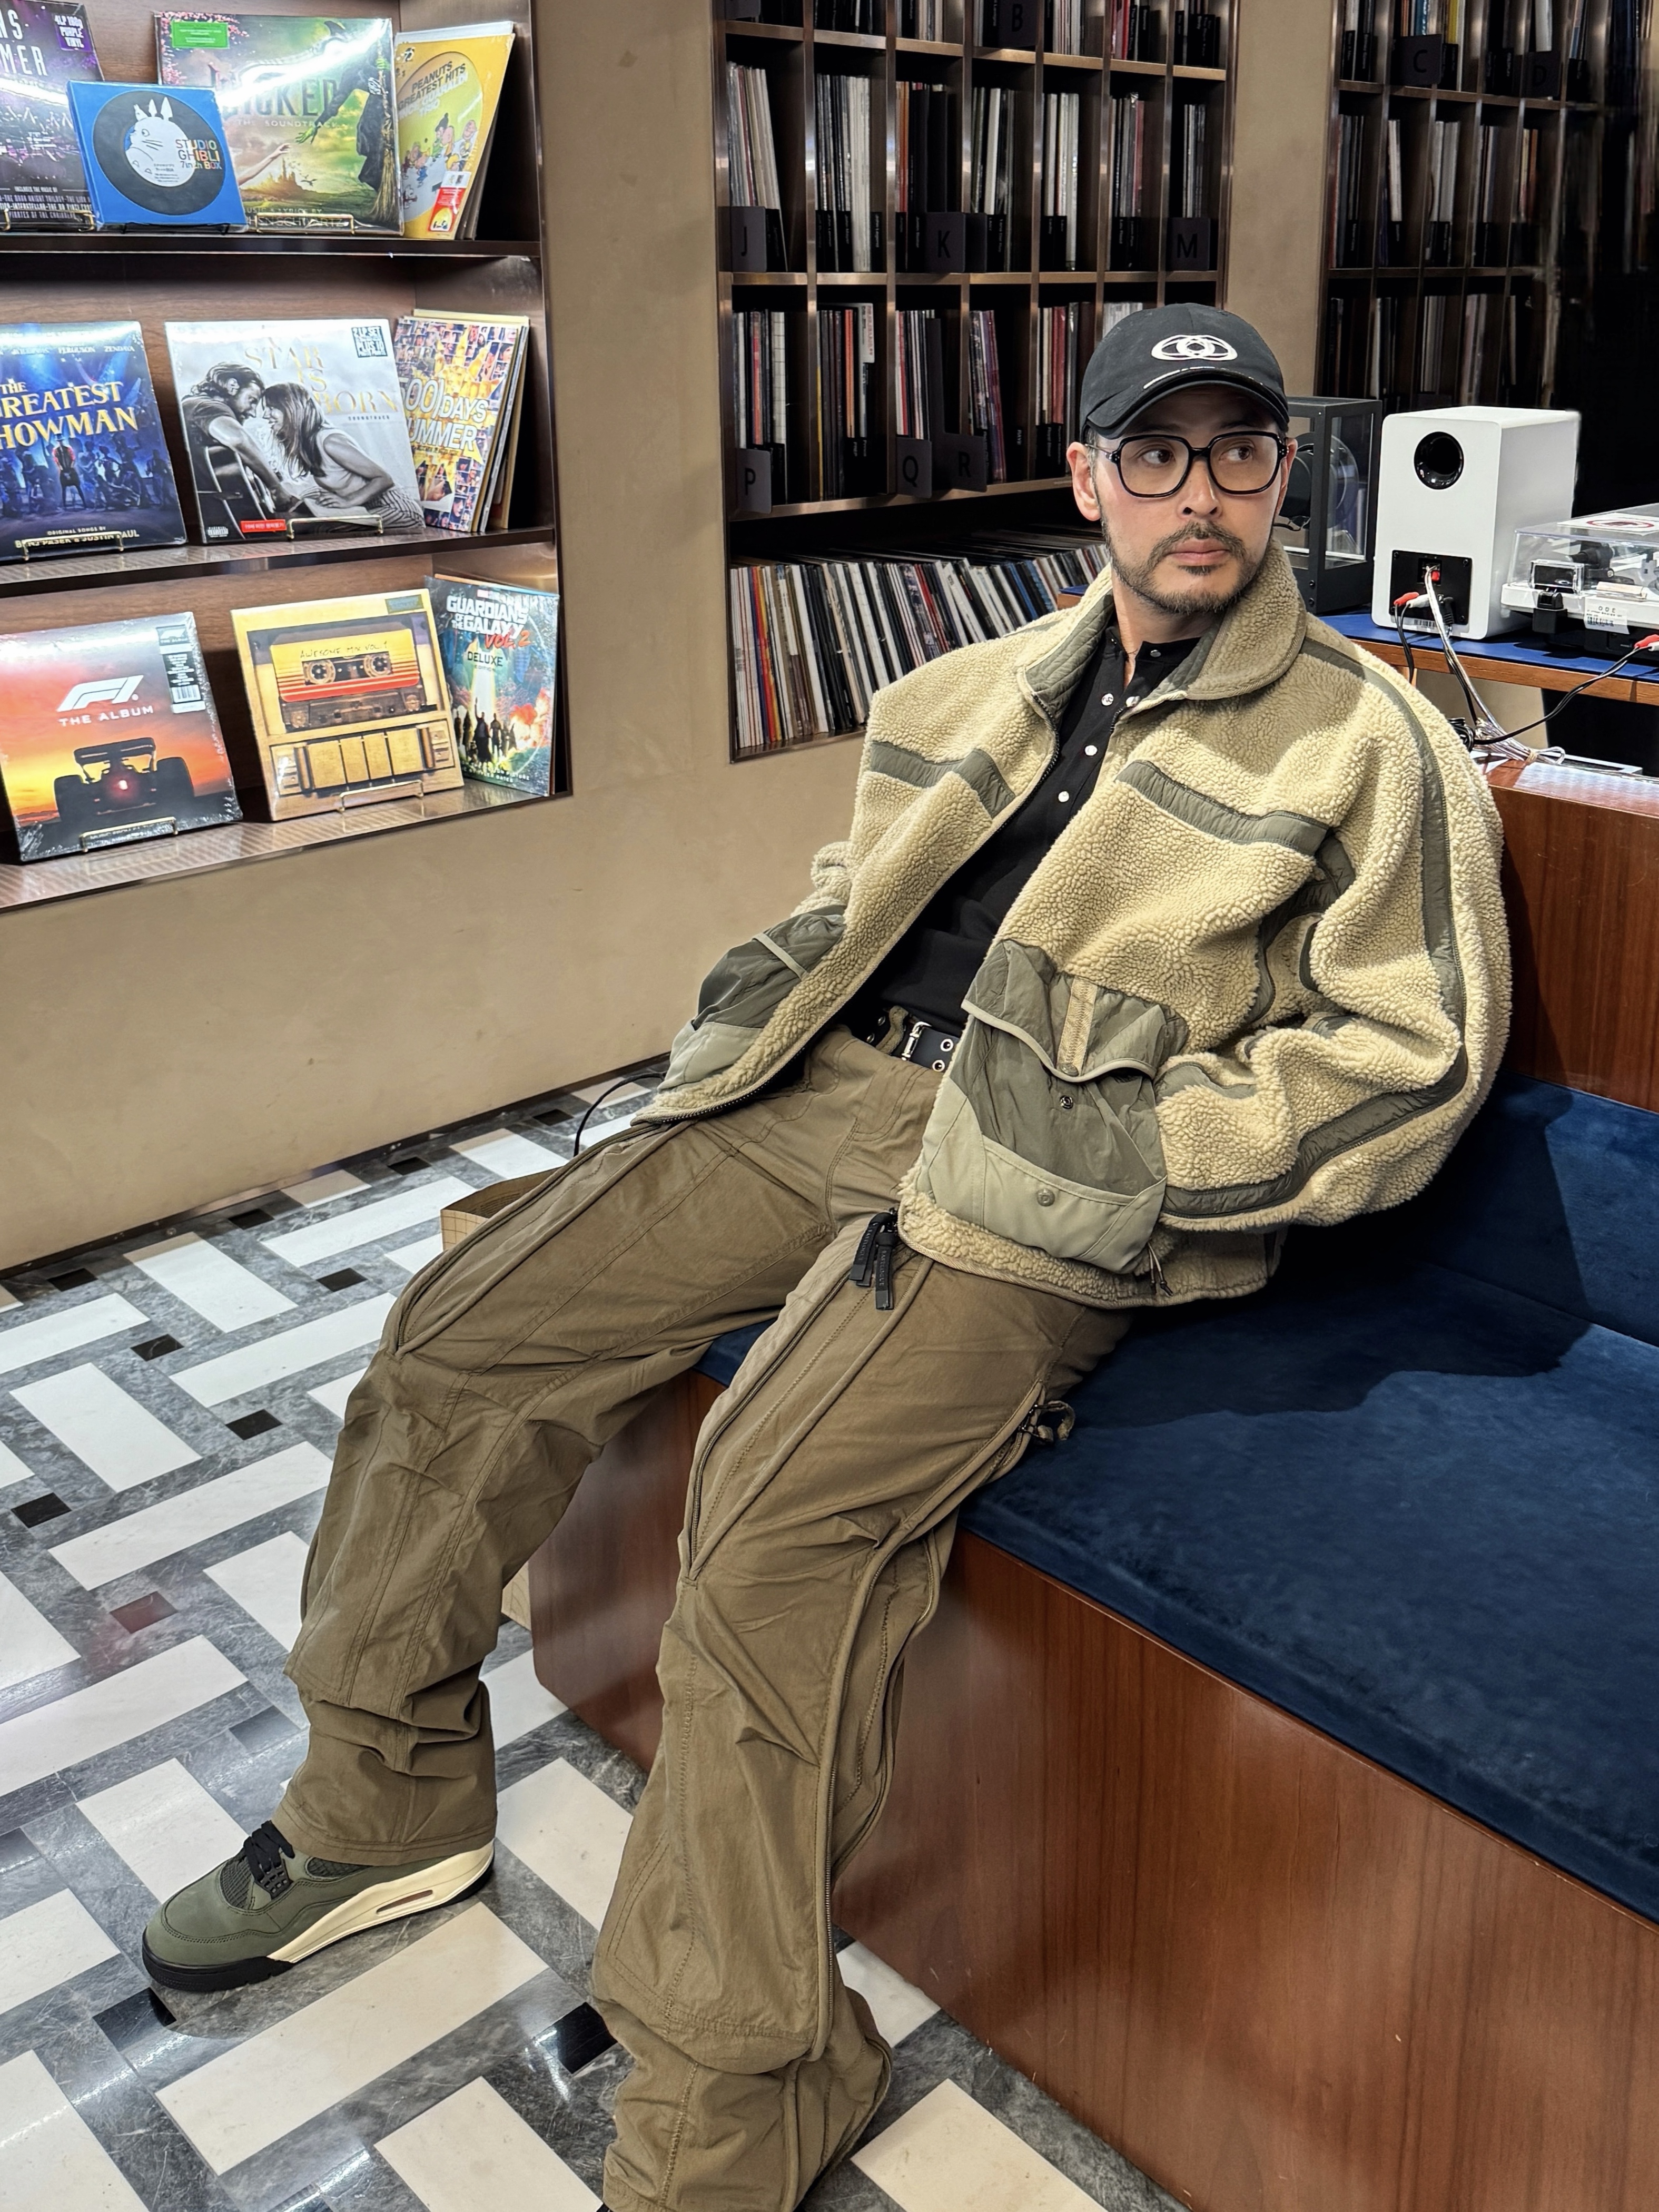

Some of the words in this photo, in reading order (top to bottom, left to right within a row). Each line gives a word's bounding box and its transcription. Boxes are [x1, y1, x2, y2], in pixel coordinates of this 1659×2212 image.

[1012, 4, 1023, 32] B
[1413, 49, 1427, 73] C
[397, 76, 443, 111] GREATEST
[445, 63, 466, 83] HITS
[412, 61, 452, 93] PEANUTS
[175, 139, 217, 151] STUDIO
[178, 149, 221, 162] GHIBLI
[203, 161, 222, 170] BOX
[741, 226, 748, 257] J
[938, 230, 951, 258] K
[1177, 233, 1198, 259] M
[0, 381, 28, 395] THE
[0, 381, 124, 419] REATEST
[438, 395, 489, 424] DAYS
[0, 407, 139, 449] HOWMAN
[407, 417, 478, 452] UMMER
[902, 455, 919, 487] Q
[959, 451, 971, 478] R
[744, 468, 756, 496] P
[446, 595, 529, 625] GUARDIANS
[455, 613, 465, 622] OF
[463, 614, 525, 640] GALAXY
[485, 633, 517, 649] VOL.
[518, 630, 532, 648] 2
[300, 647, 341, 658] AWESOME
[468, 651, 503, 667] DELUXE
[58, 714, 92, 727] THE
[97, 705, 154, 722] ALBUM
